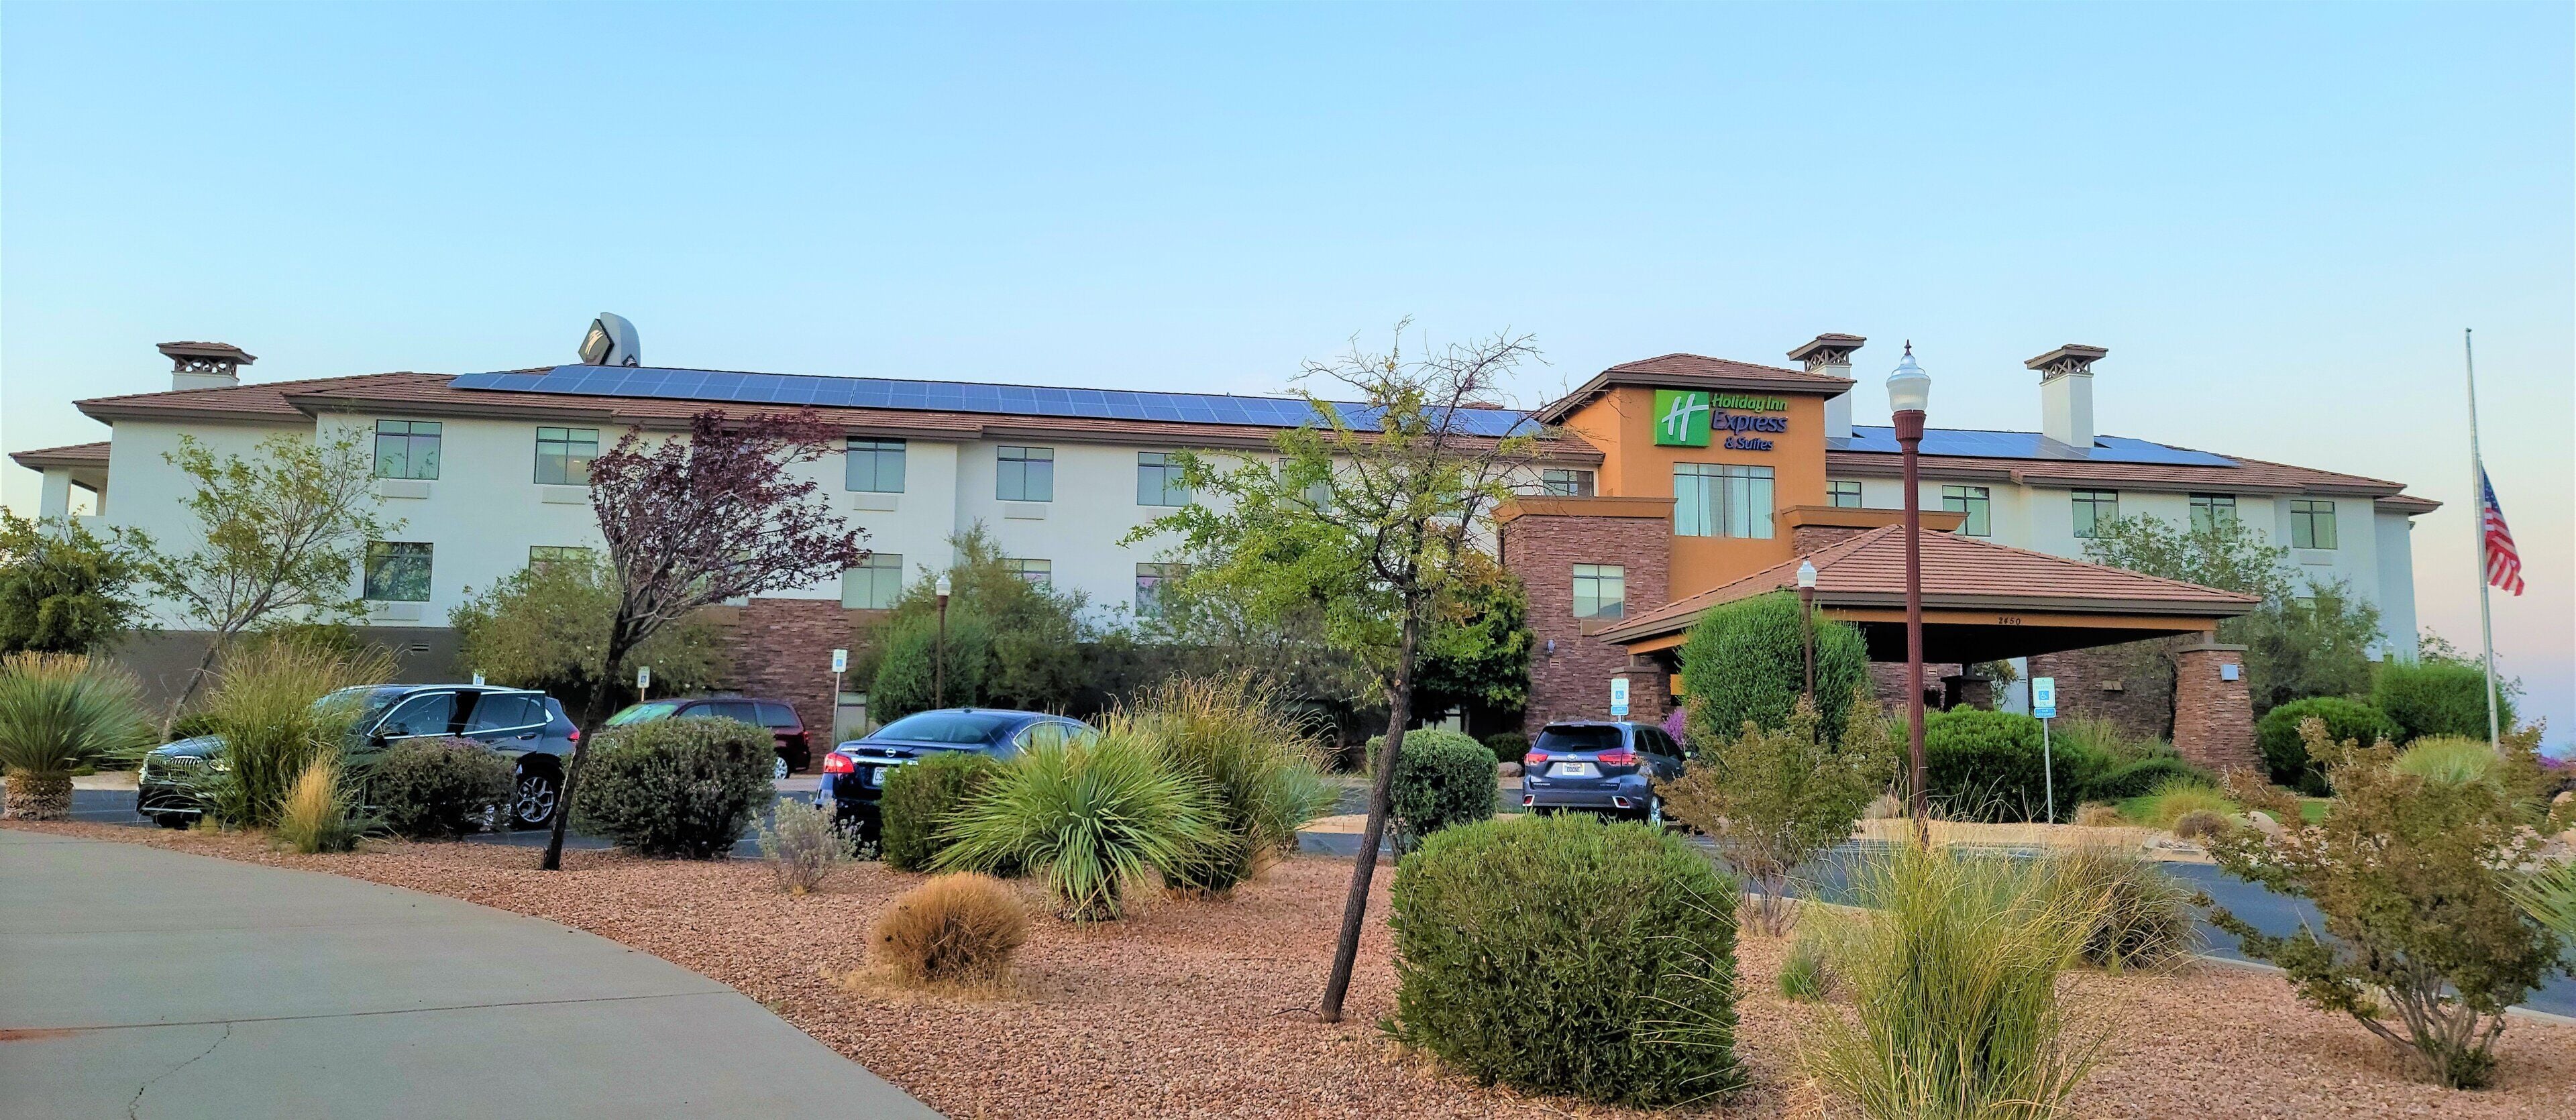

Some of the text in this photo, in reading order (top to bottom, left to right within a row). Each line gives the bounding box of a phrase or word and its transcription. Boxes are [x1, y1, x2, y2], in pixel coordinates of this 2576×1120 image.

[1712, 394, 1788, 413] Holiday Inn
[1712, 410, 1788, 435] Express
[1725, 437, 1774, 450] & Suites
[1998, 617, 2021, 625] 2450
